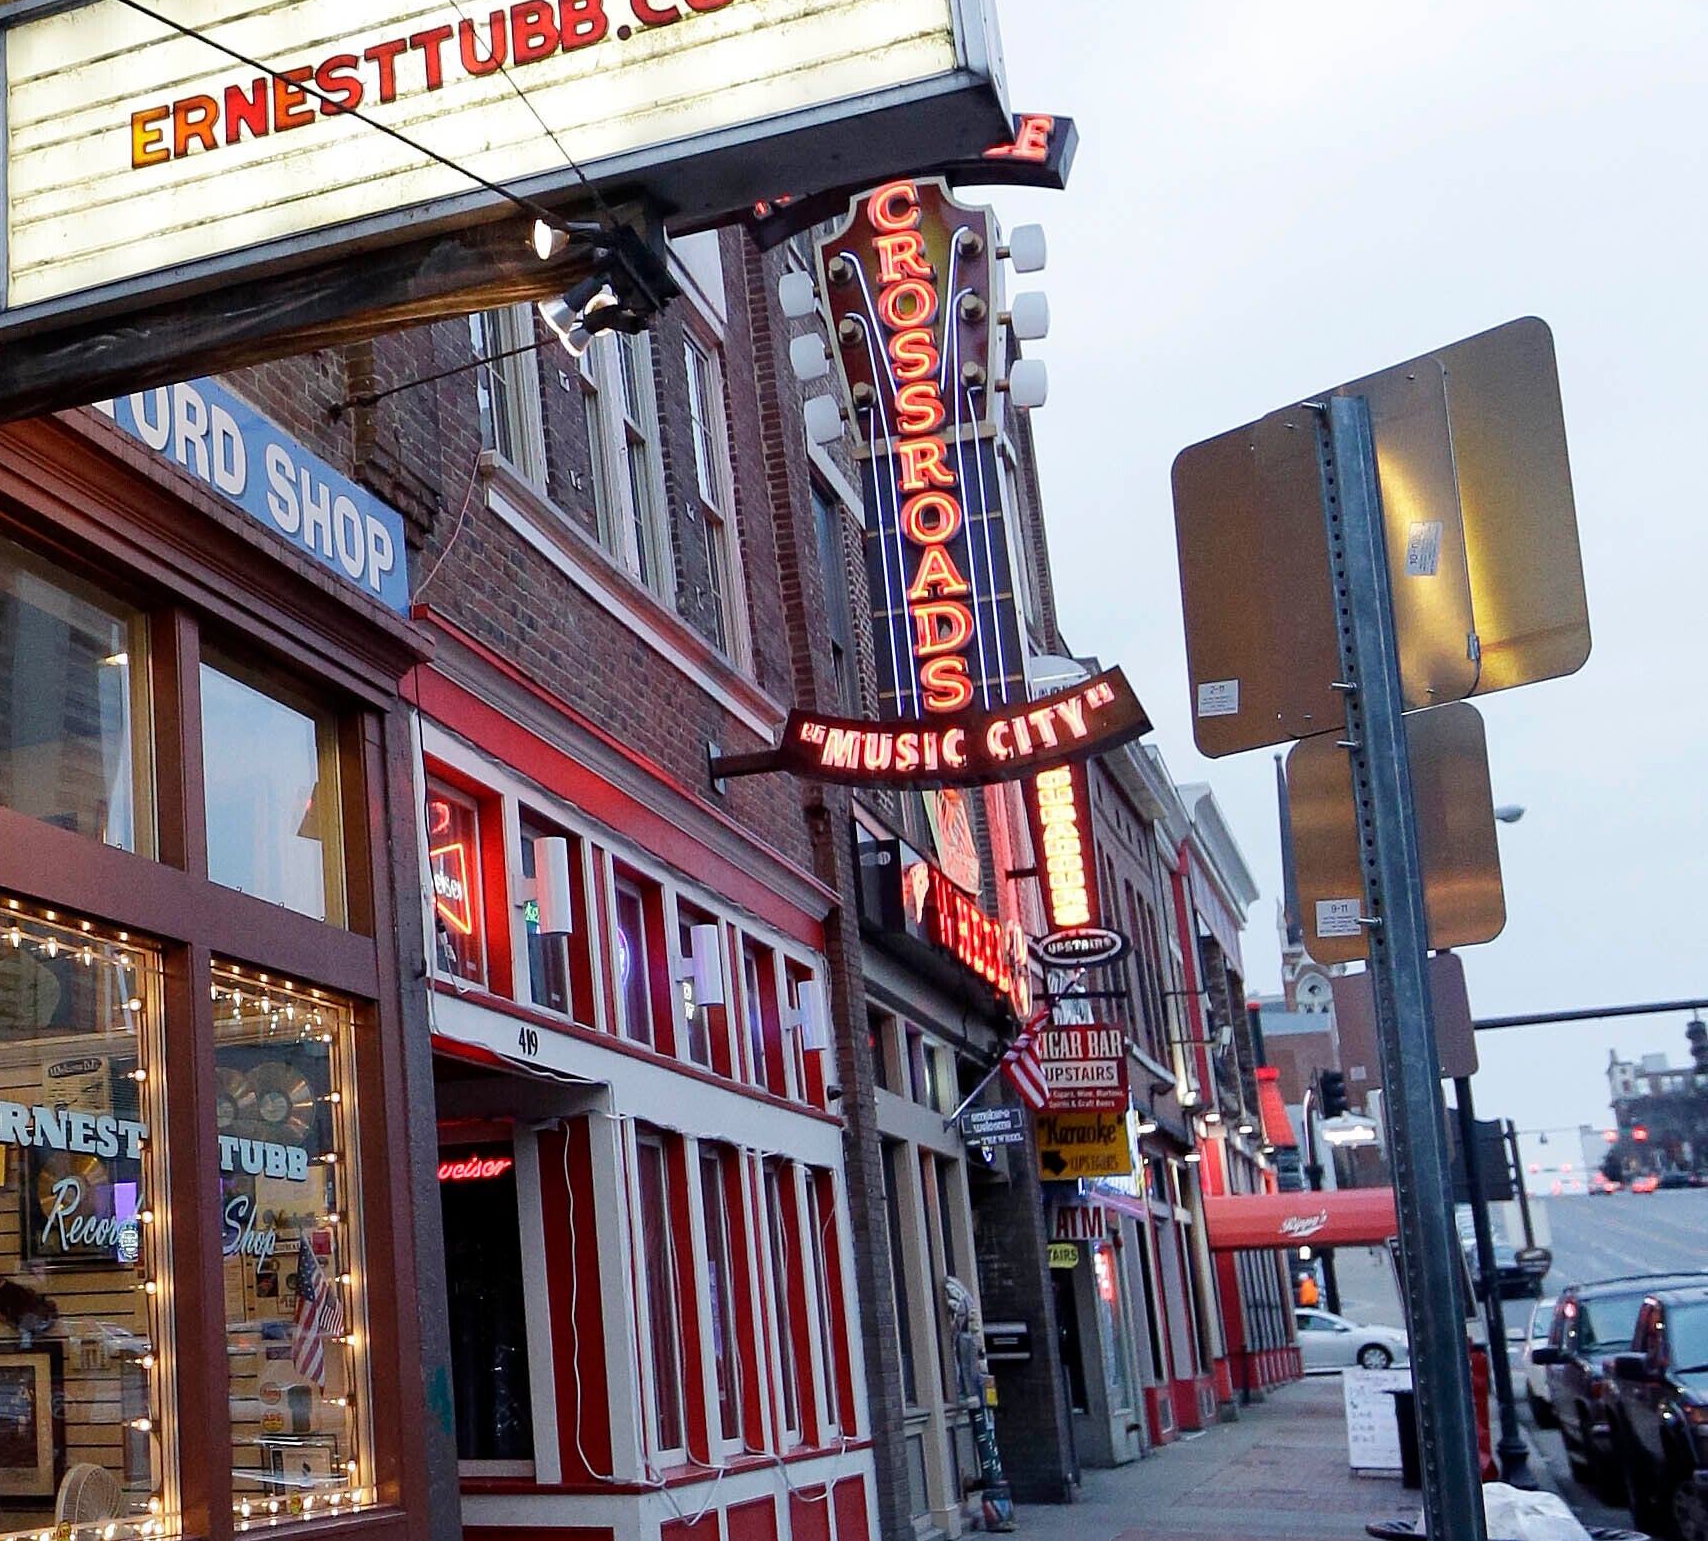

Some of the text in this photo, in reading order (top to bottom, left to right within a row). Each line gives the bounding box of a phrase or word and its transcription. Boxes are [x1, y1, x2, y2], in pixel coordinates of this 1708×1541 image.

[867, 179, 974, 713] CROSSROADS
[265, 443, 394, 593] SHOP
[517, 1027, 539, 1057] 419
[1087, 1029, 1124, 1058] BAR
[218, 1135, 309, 1181] TUBB
[438, 1155, 512, 1182] eiser
[223, 1194, 277, 1275] Shop
[1056, 1206, 1105, 1238] ATM
